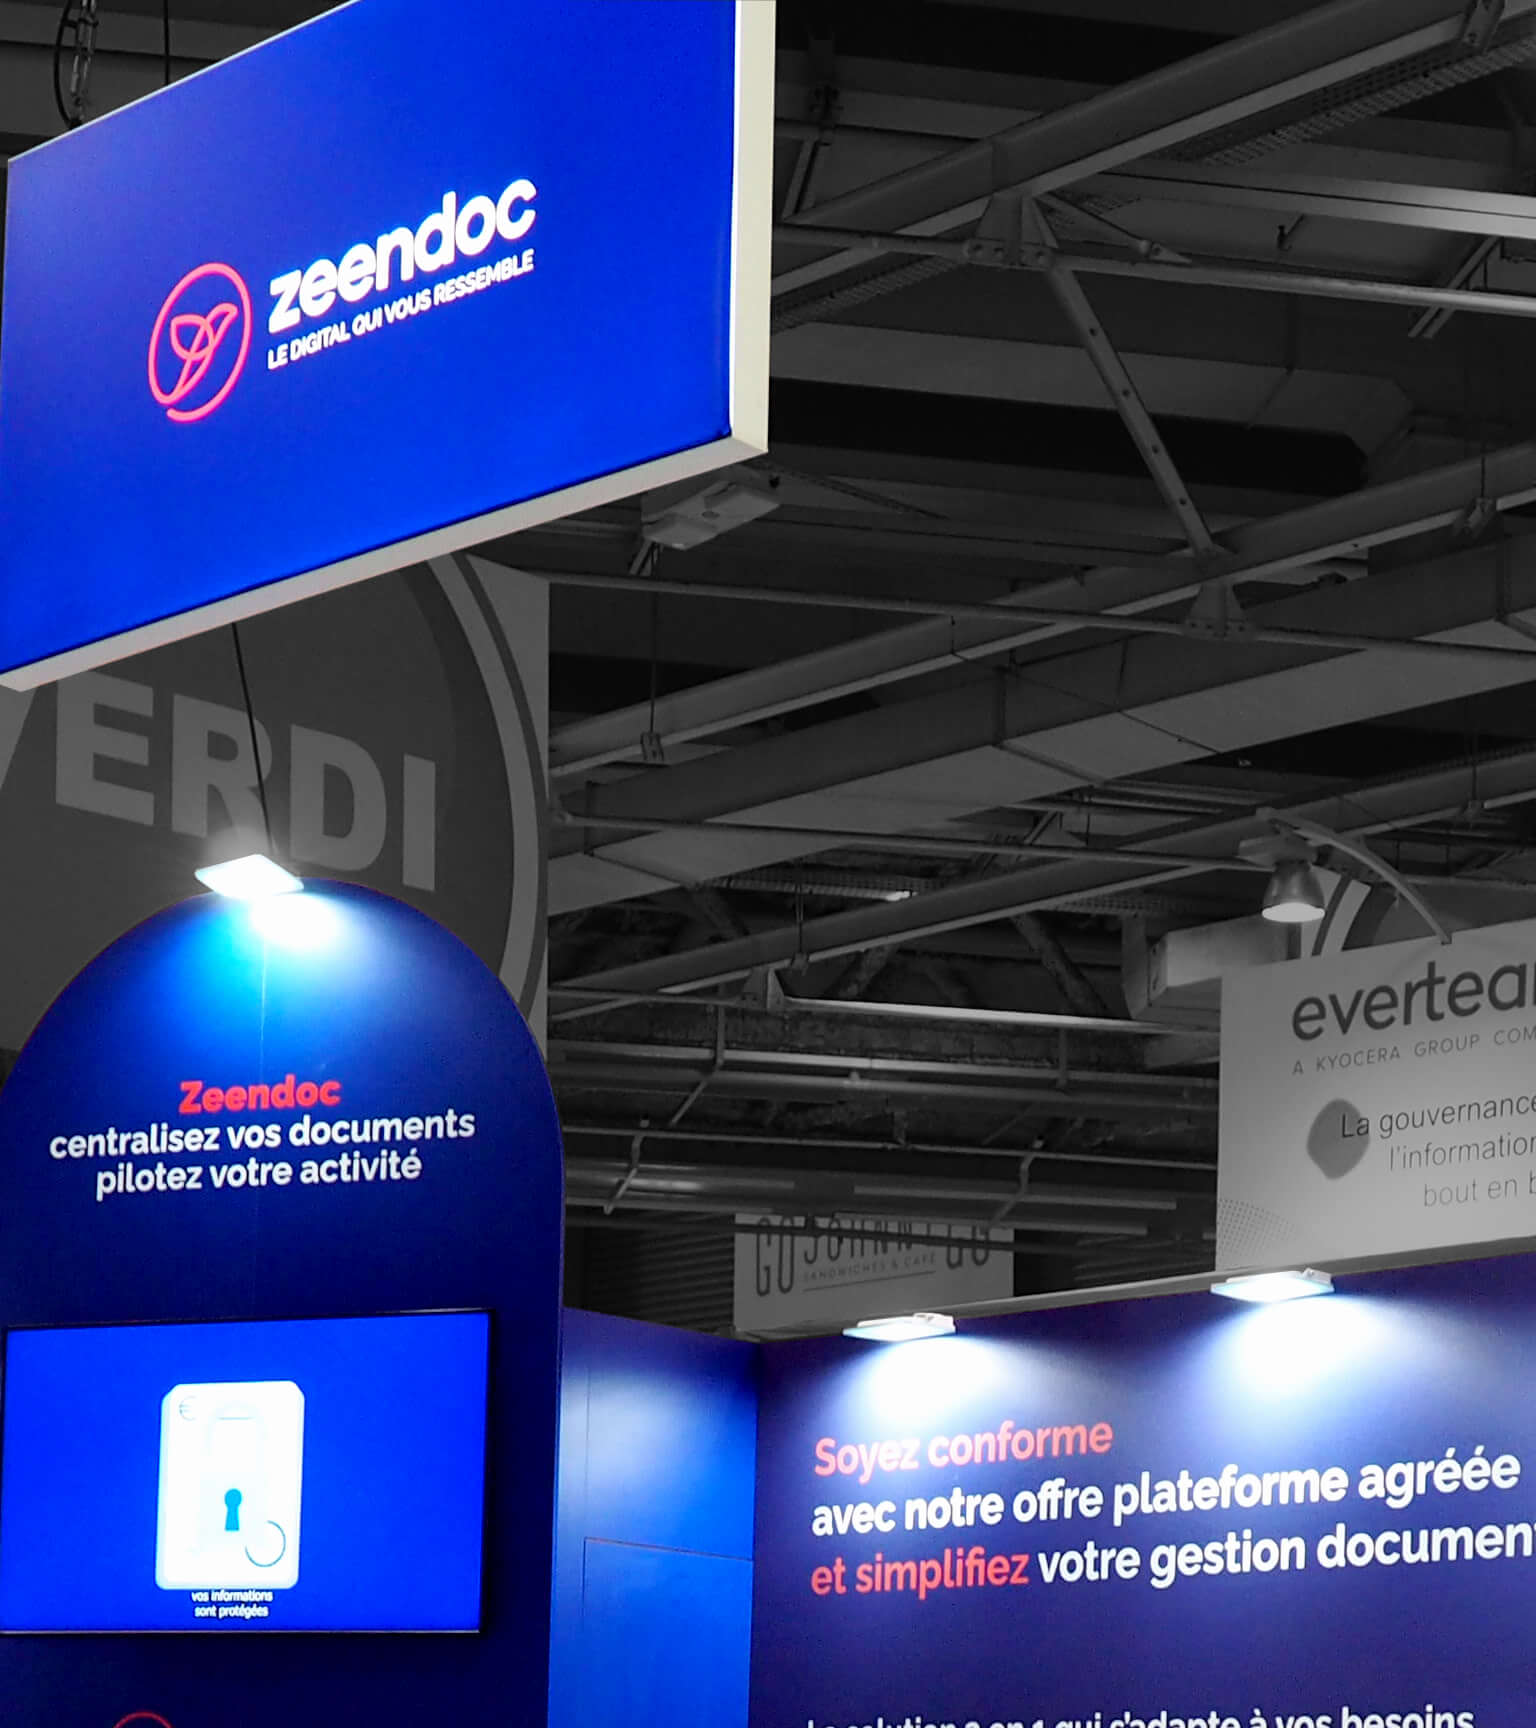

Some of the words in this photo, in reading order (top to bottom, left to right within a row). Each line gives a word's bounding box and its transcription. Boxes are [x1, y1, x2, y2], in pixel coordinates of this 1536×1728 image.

[269, 177, 538, 333] zeendoc
[268, 344, 288, 370] LE
[290, 321, 352, 361] DIGITAL
[353, 310, 384, 338] QUI
[385, 289, 432, 324] VOUS
[434, 249, 536, 306] RESSEMBLE
[1293, 1059, 1304, 1075] A
[1316, 1046, 1400, 1073] KYOCERA
[1414, 1034, 1481, 1058] GROUP
[179, 1075, 341, 1114] Zeendoc
[50, 1124, 220, 1159] centralisez
[228, 1124, 282, 1149] vos
[289, 1110, 475, 1147] documents
[1341, 1114, 1369, 1138] La
[96, 1162, 202, 1202] pilotez
[210, 1158, 291, 1188] votre
[301, 1149, 422, 1185] activité
[1424, 1180, 1477, 1207] bout
[1488, 1179, 1518, 1199] en
[814, 1436, 920, 1486] Soyez
[929, 1419, 1113, 1471] conforme
[812, 1499, 896, 1537] avec
[905, 1486, 1003, 1532] notre
[1013, 1481, 1103, 1524] offre
[1113, 1463, 1348, 1526] plateforme
[1358, 1445, 1521, 1511] agréée
[811, 1557, 847, 1596] et
[856, 1545, 1030, 1600] simplifiez
[1039, 1537, 1141, 1584] votre
[1150, 1530, 1306, 1590] gestion
[192, 1591, 208, 1602] vos
[212, 1590, 272, 1602] informations
[195, 1605, 216, 1616] sont
